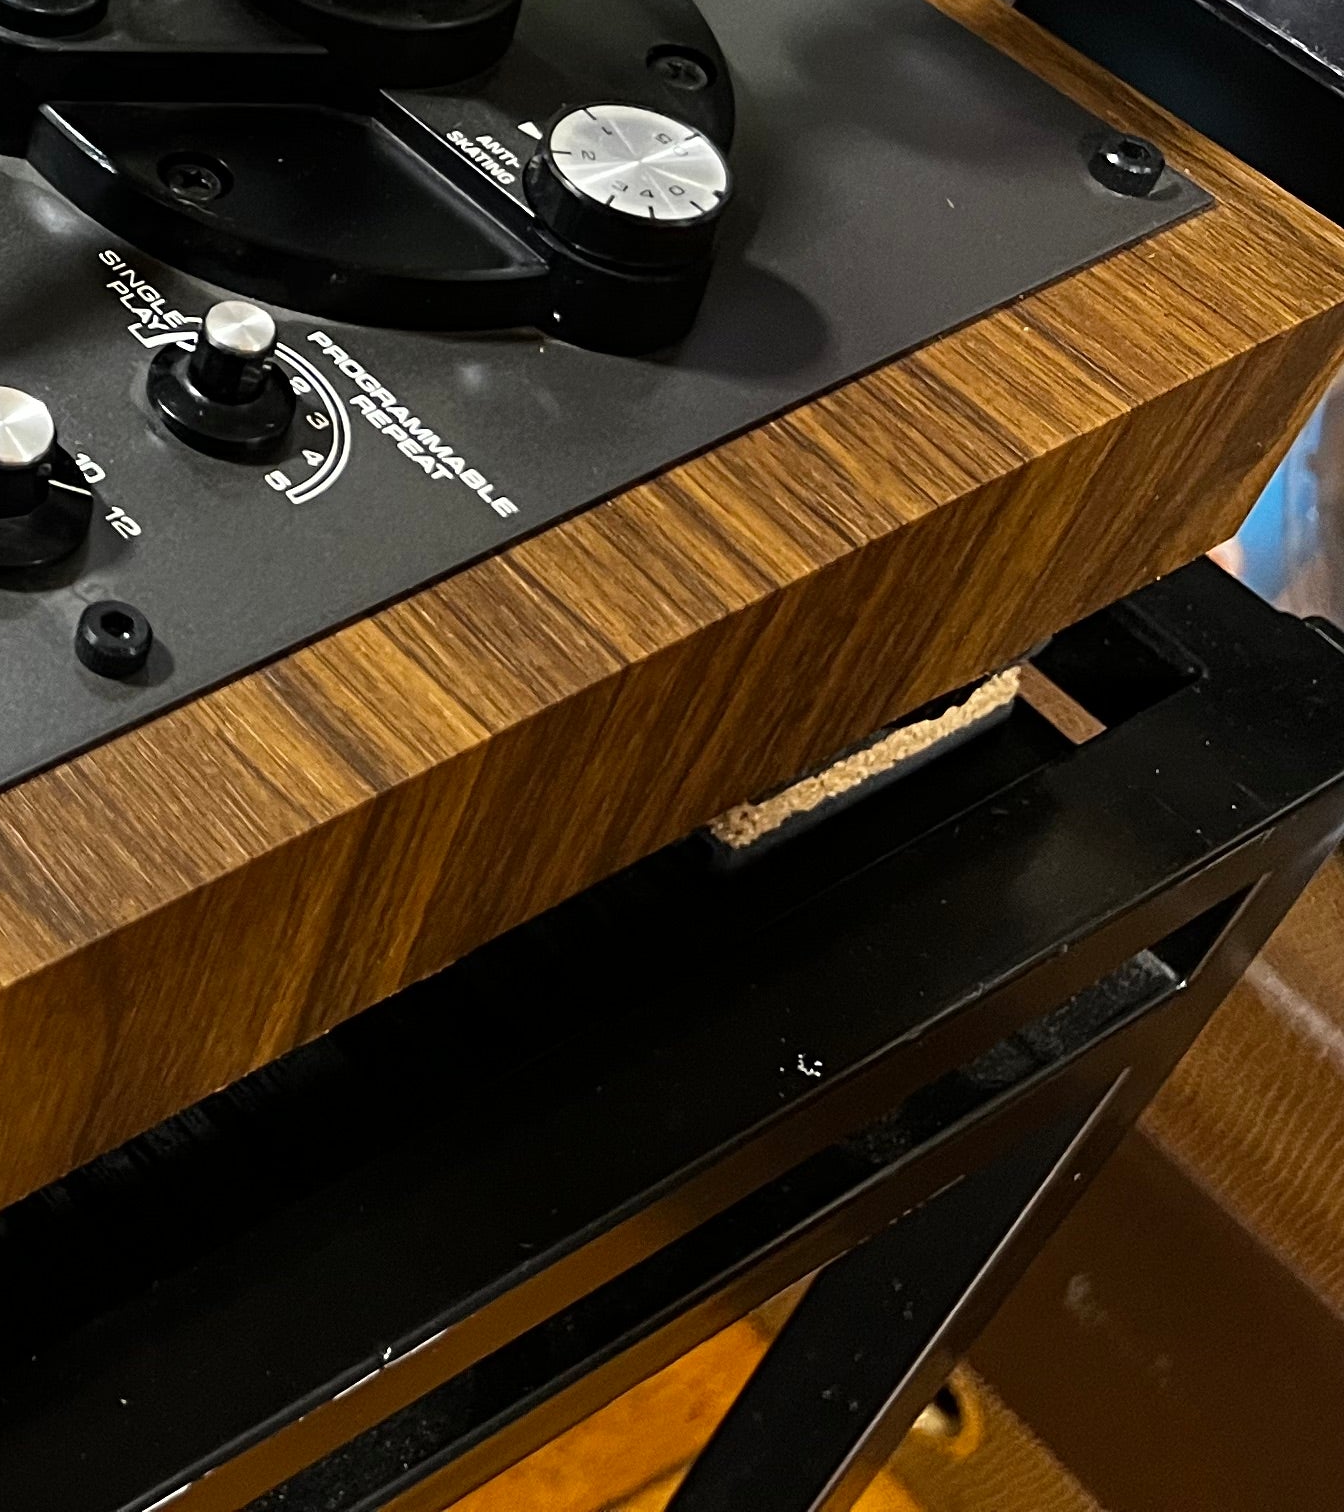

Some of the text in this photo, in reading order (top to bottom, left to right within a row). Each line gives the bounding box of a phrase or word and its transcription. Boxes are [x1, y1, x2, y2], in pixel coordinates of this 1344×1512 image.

[446, 130, 515, 185] SKATING
[476, 135, 520, 168] ANTI-
[98, 250, 185, 329] SINGLE
[106, 280, 170, 330] PLAY
[306, 411, 329, 429] 3
[307, 331, 520, 517] PROGRAMMABLE
[349, 394, 454, 480] REPEAT
[75, 453, 106, 484] 10
[302, 449, 324, 466] 4
[264, 470, 291, 491] 5
[105, 506, 142, 539] 12
